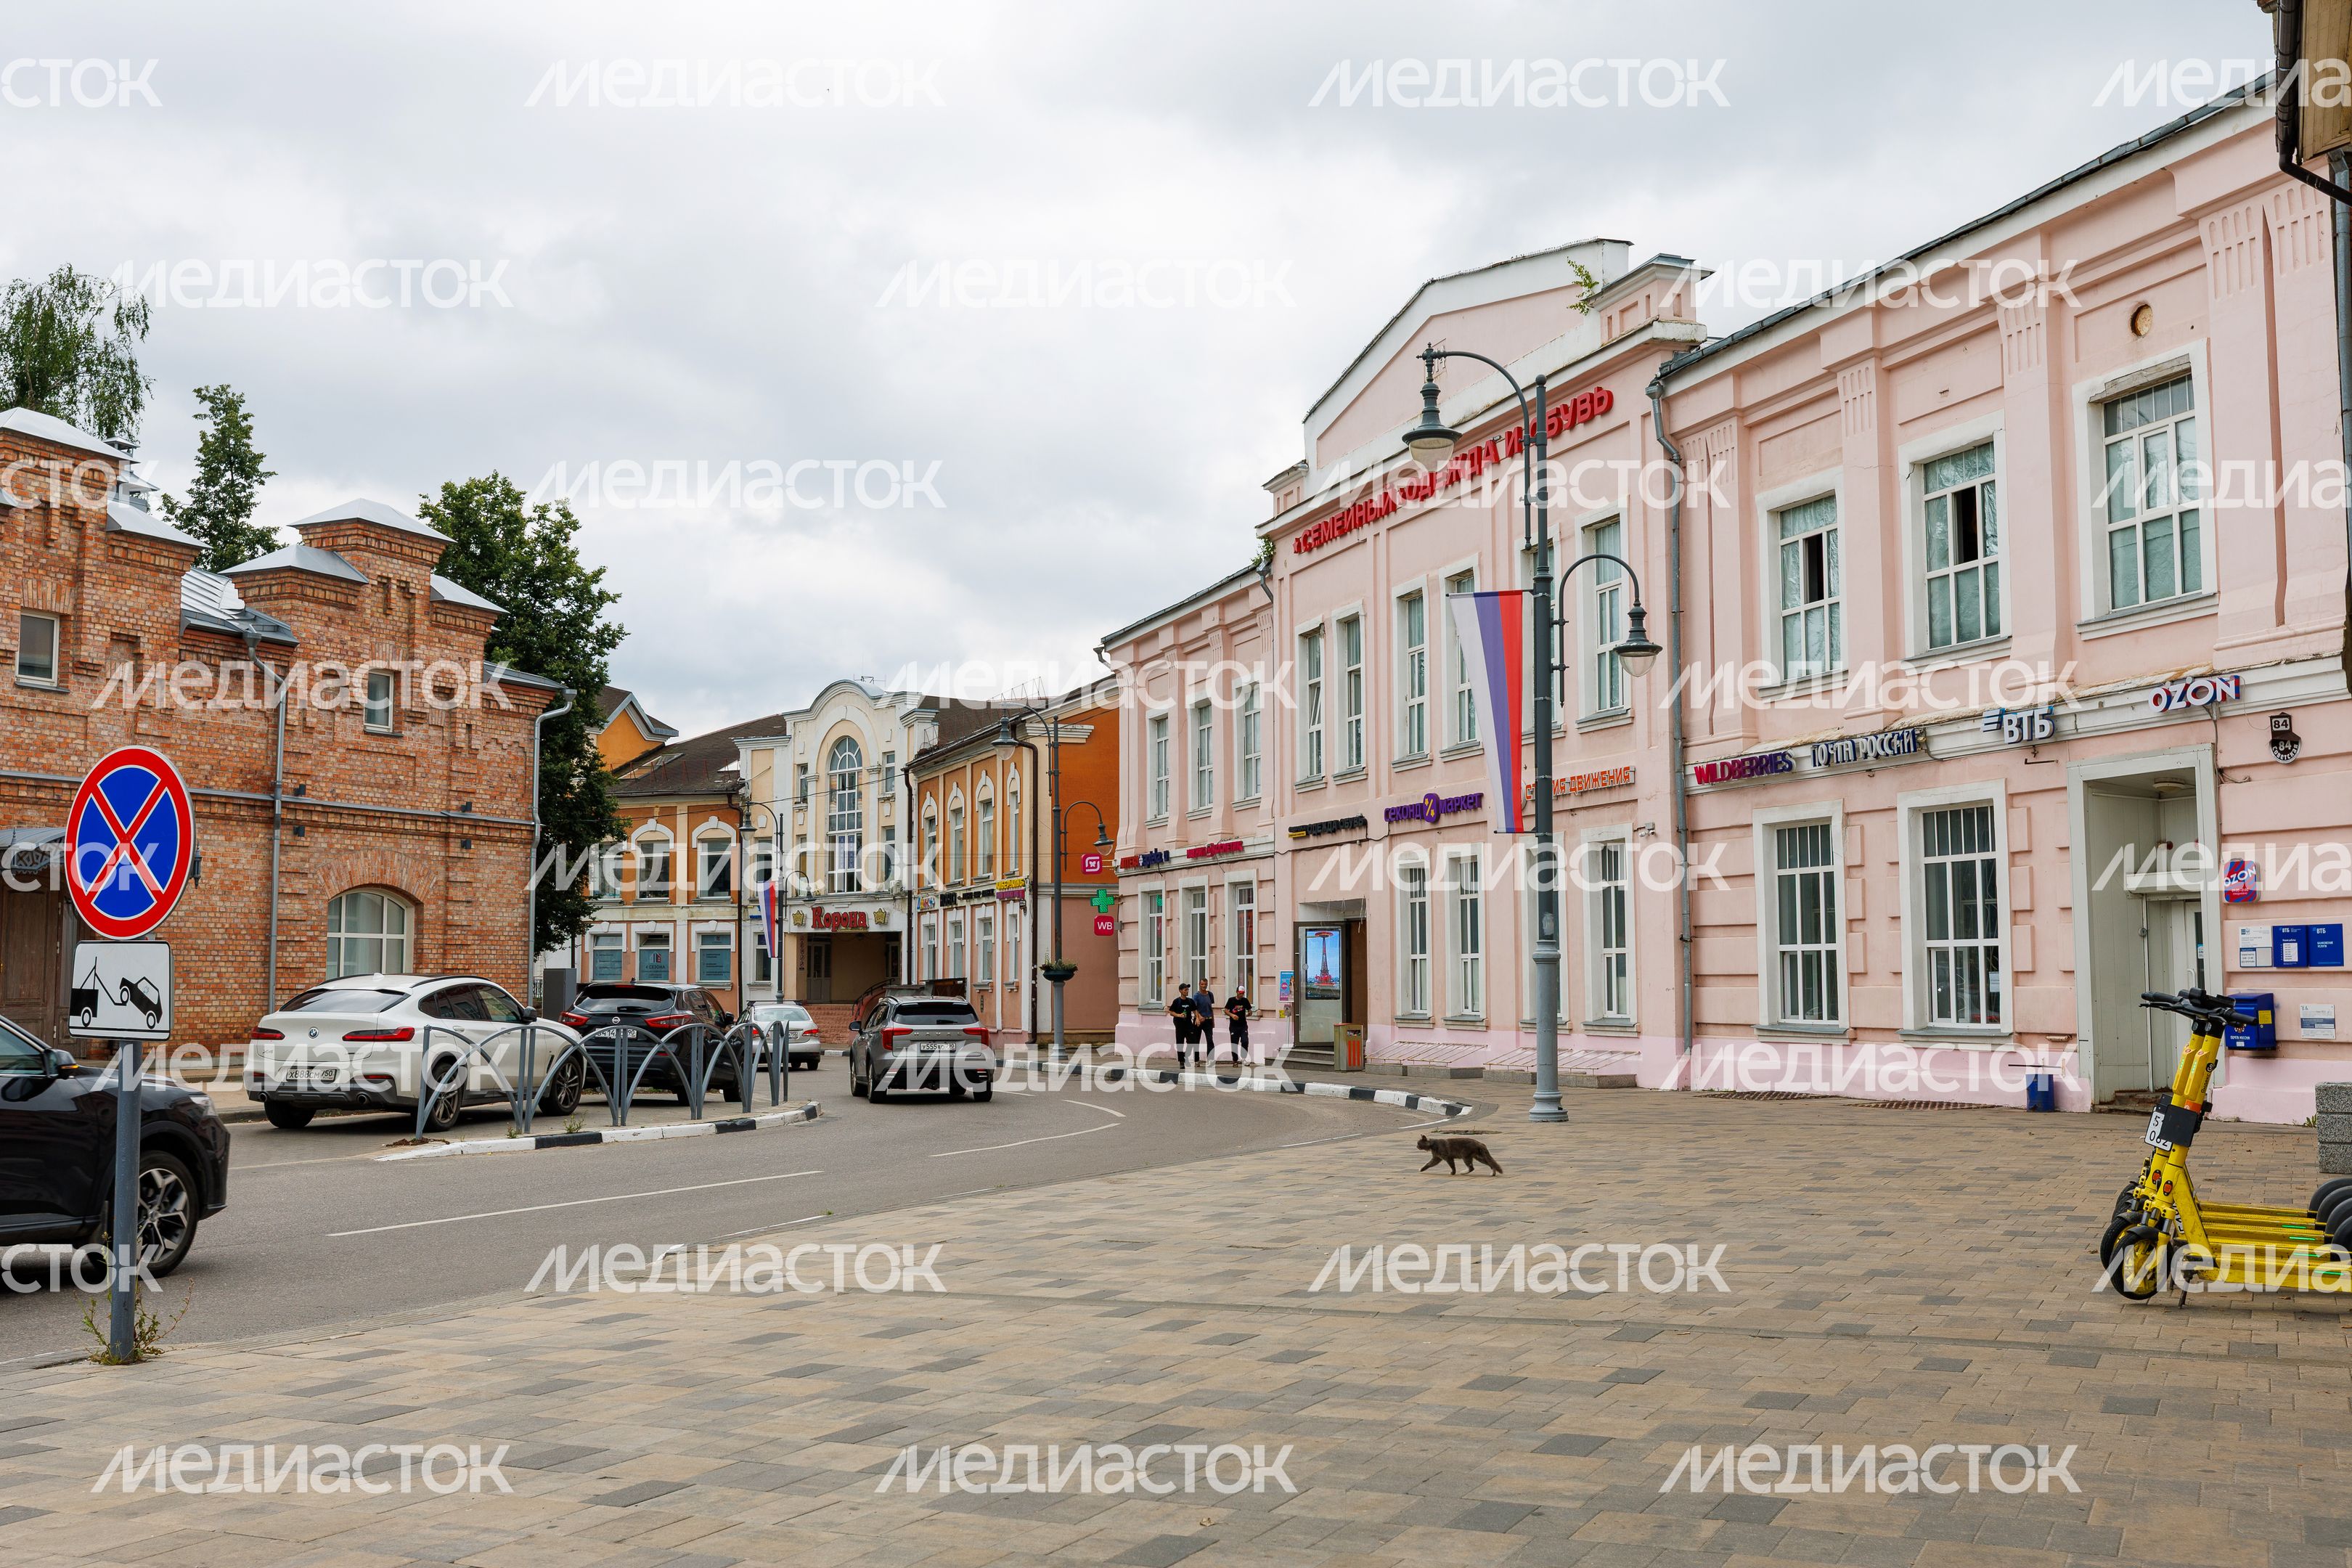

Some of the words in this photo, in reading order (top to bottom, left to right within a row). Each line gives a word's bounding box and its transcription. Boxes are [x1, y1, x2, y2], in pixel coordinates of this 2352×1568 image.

[1505, 426, 1523, 458] И
[2148, 674, 2240, 713] OZON
[2004, 706, 2056, 744] ВТБ
[2274, 719, 2288, 729] 84
[1811, 738, 1857, 768] ПОЧТА
[1858, 728, 1918, 759] РОССИИ
[2278, 740, 2292, 751] 84
[1694, 749, 1795, 785] WILDBERRIES
[1525, 778, 1566, 800] СИЯ
[1569, 766, 1630, 796] ДВИЖЕНИЯ
[2224, 866, 2256, 887] OZON
[812, 906, 870, 932] Корона
[1097, 921, 1113, 930] WB
[2207, 1063, 2213, 1072] Go
